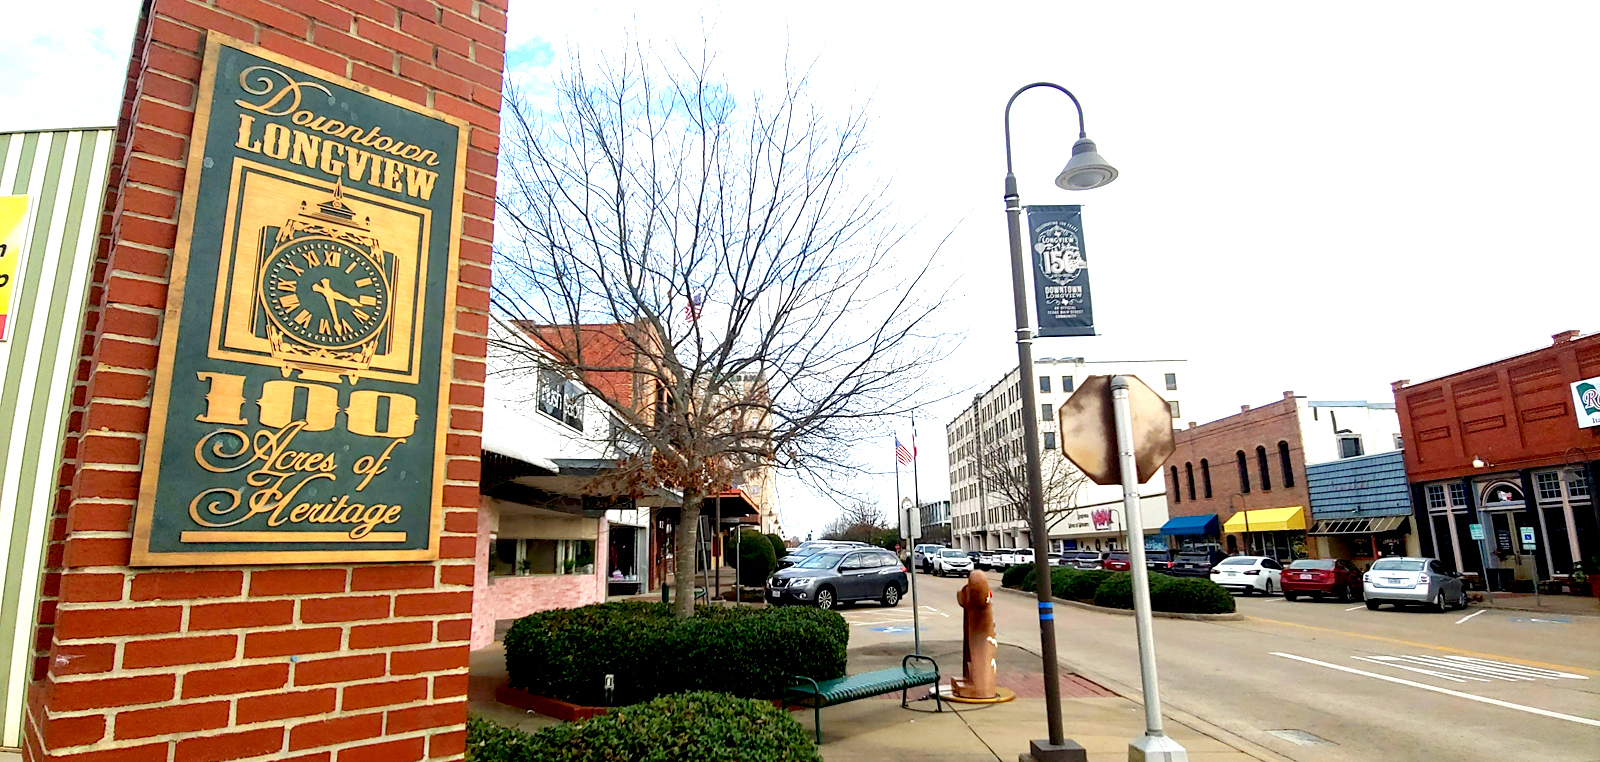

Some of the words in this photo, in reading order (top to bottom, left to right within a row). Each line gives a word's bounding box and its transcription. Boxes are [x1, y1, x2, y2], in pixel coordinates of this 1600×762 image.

[234, 65, 440, 167] Downtown
[235, 113, 439, 201] LONGVIEW
[195, 371, 419, 438] 100
[194, 420, 337, 474] Acres
[352, 437, 407, 492] of
[188, 471, 402, 540] Heritage
